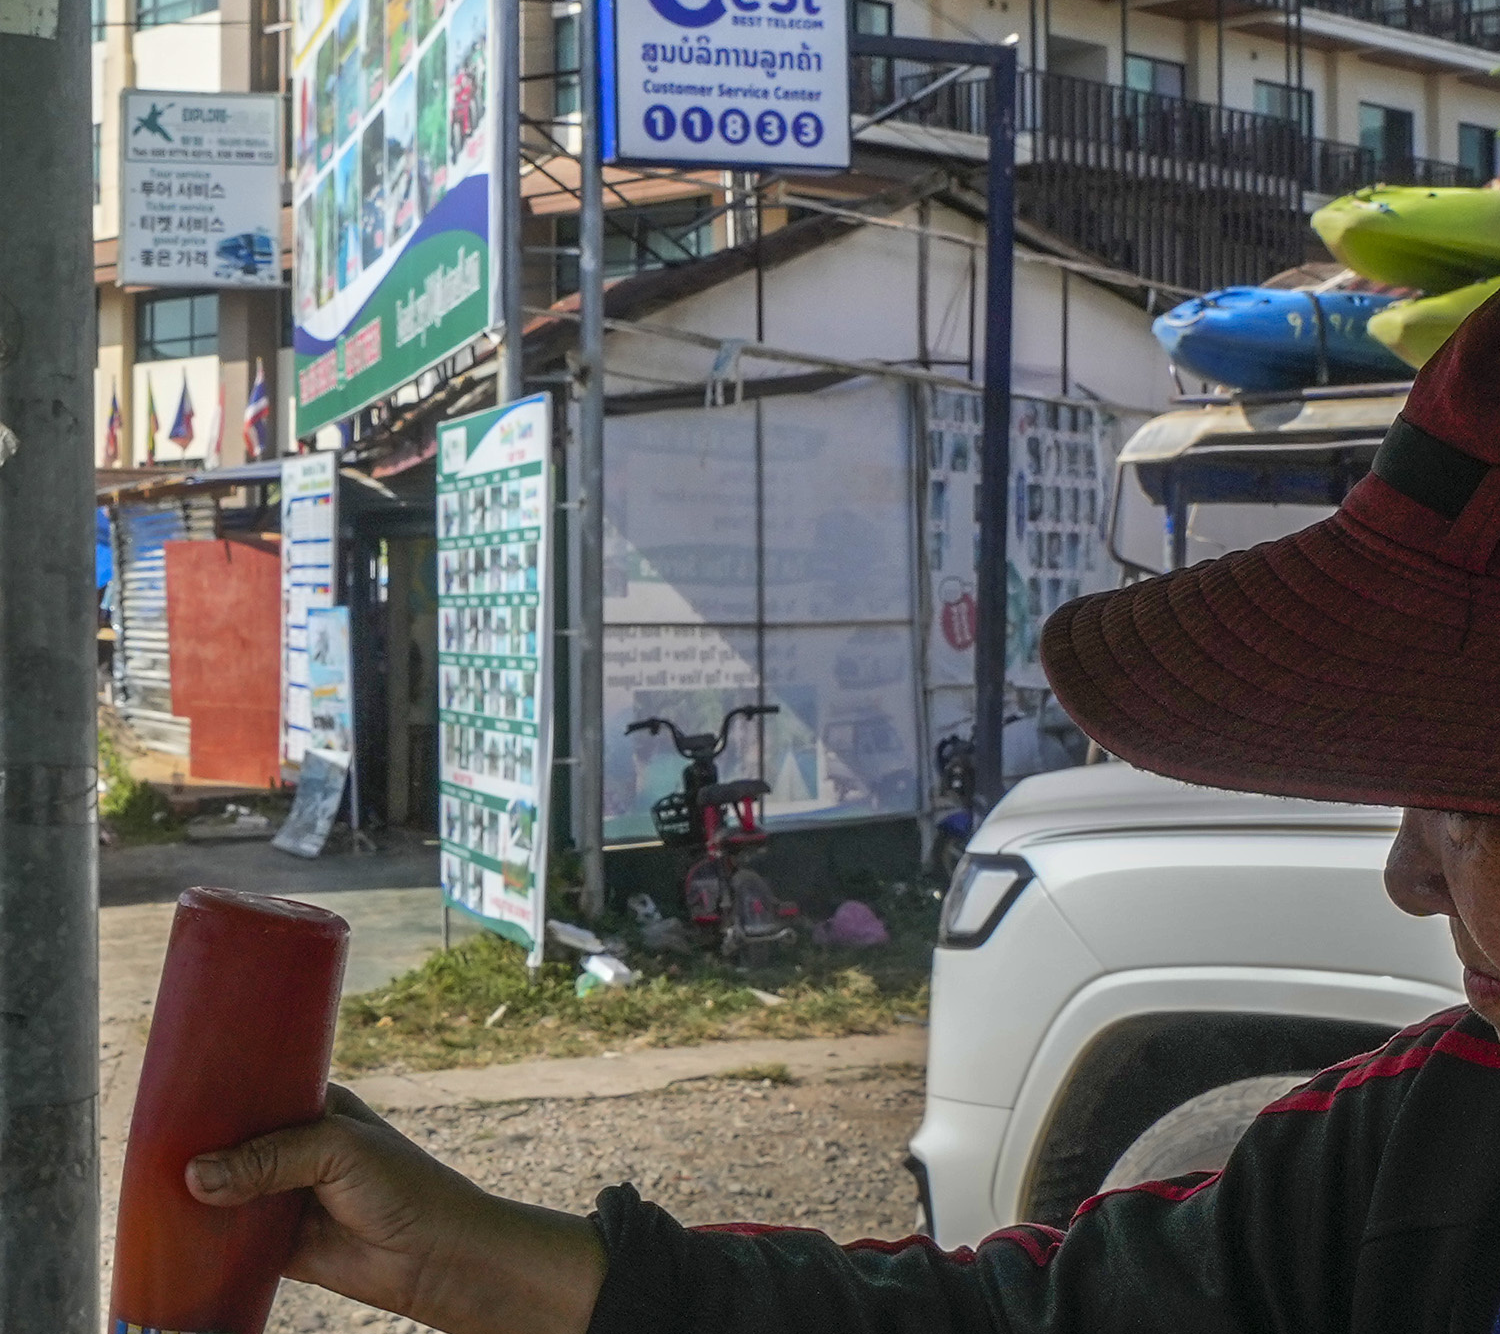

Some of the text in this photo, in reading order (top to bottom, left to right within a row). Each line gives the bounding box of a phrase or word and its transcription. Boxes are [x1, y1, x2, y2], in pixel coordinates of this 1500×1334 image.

[732, 16, 824, 30] BEST TELECOM
[642, 79, 822, 102] Customer Service Center
[644, 105, 823, 148] 11833
[175, 170, 212, 180] service
[141, 180, 226, 200] 투어 서비스
[179, 203, 214, 213] service
[140, 216, 226, 234] 티켓 서비스
[140, 249, 208, 268] 좋은 가격
